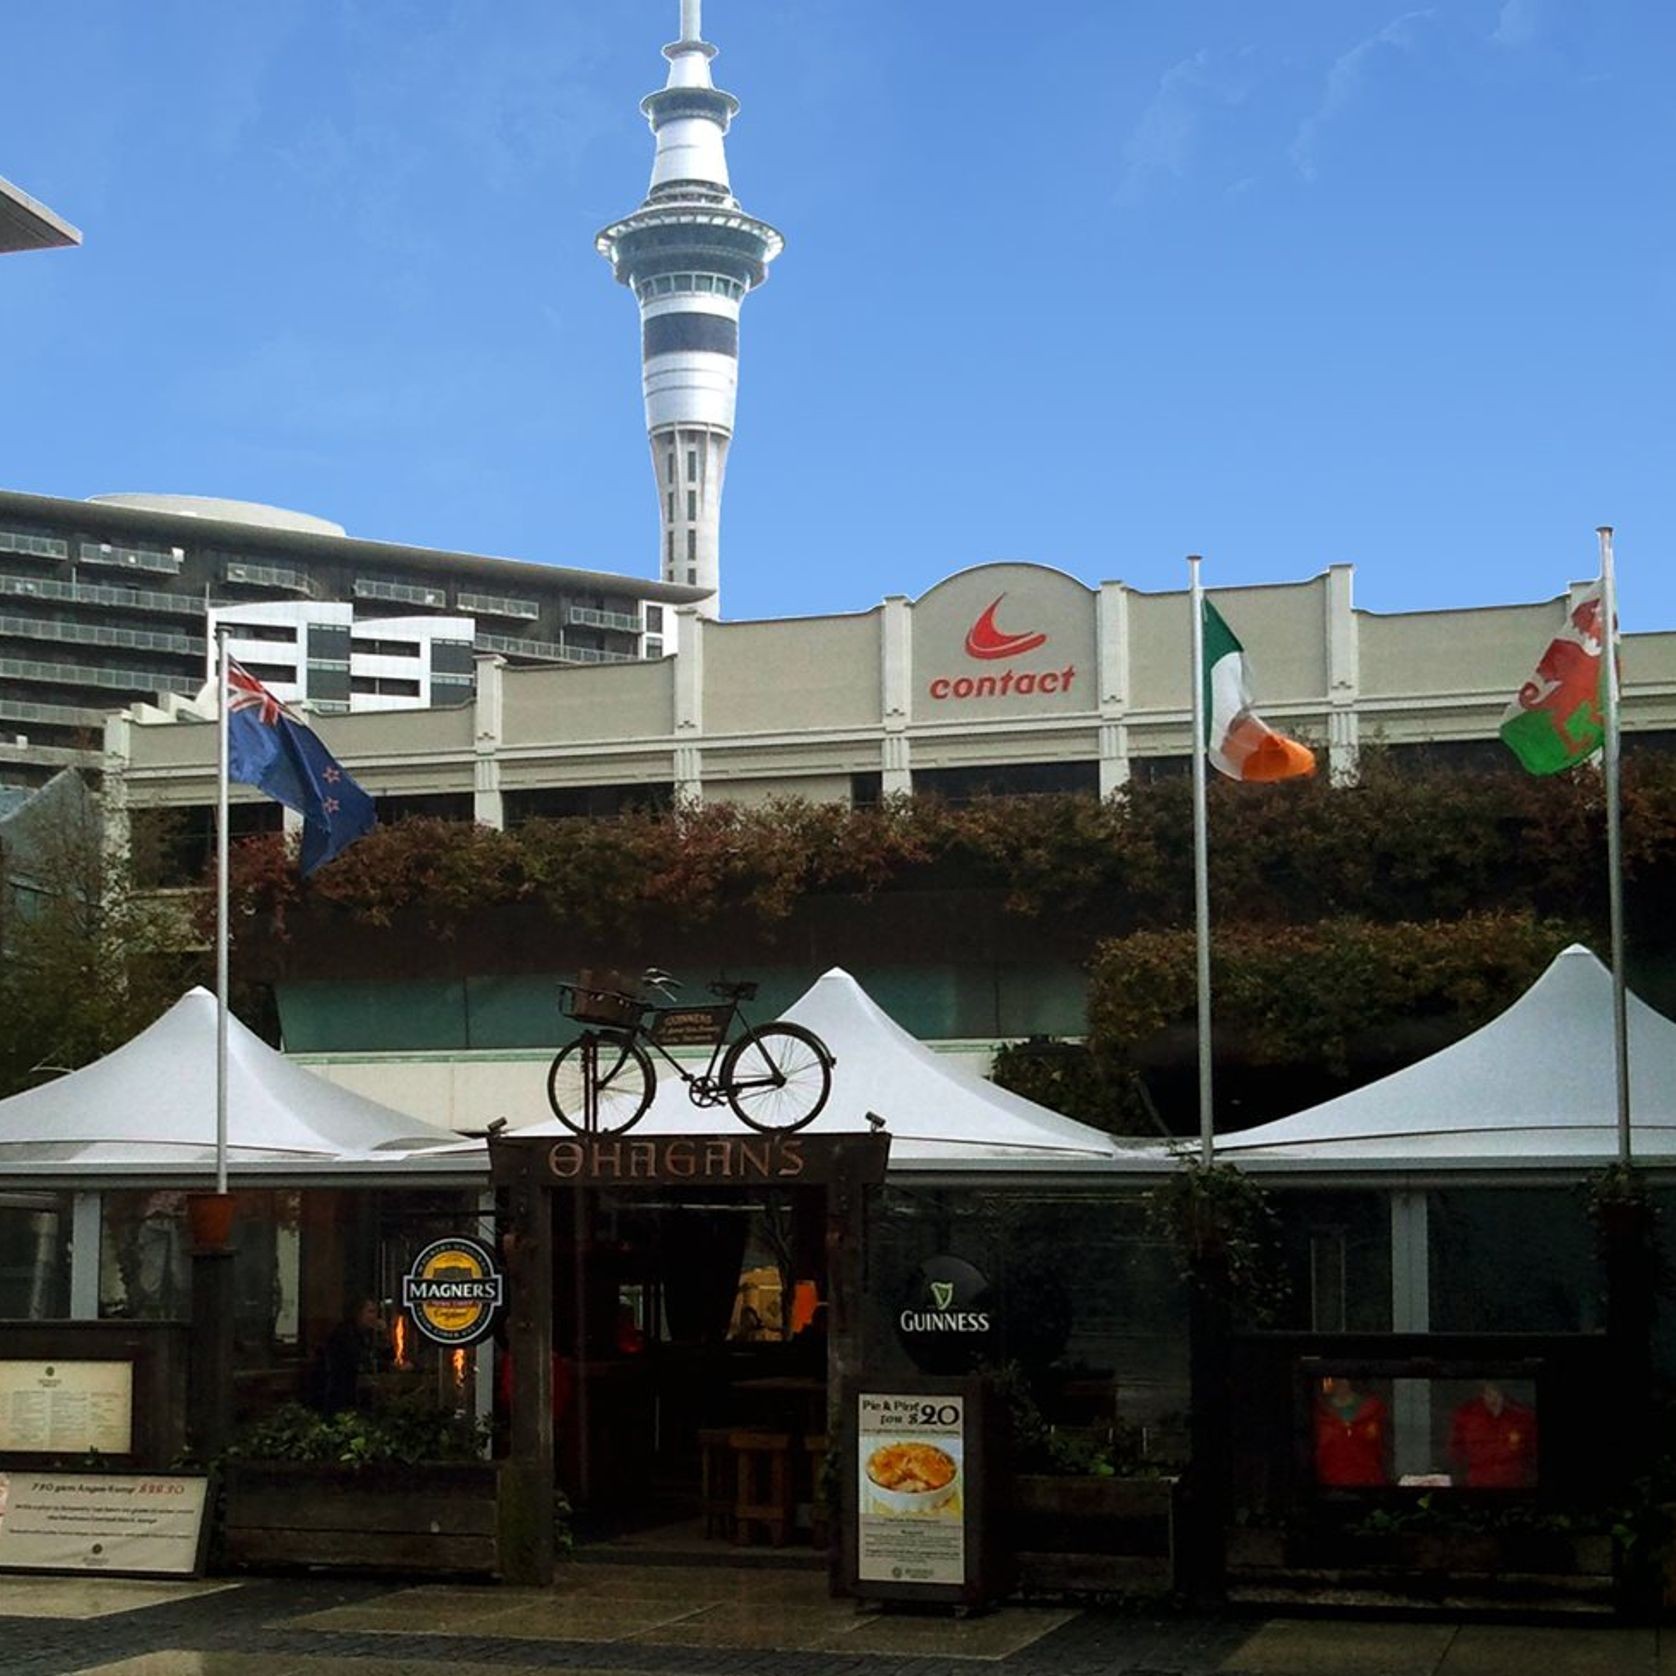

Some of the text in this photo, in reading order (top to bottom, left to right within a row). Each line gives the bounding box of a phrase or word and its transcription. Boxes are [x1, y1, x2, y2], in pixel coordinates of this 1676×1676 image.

[929, 665, 1075, 699] contact
[409, 1282, 496, 1298] MAGNERS
[900, 1310, 990, 1332] GUINNESS
